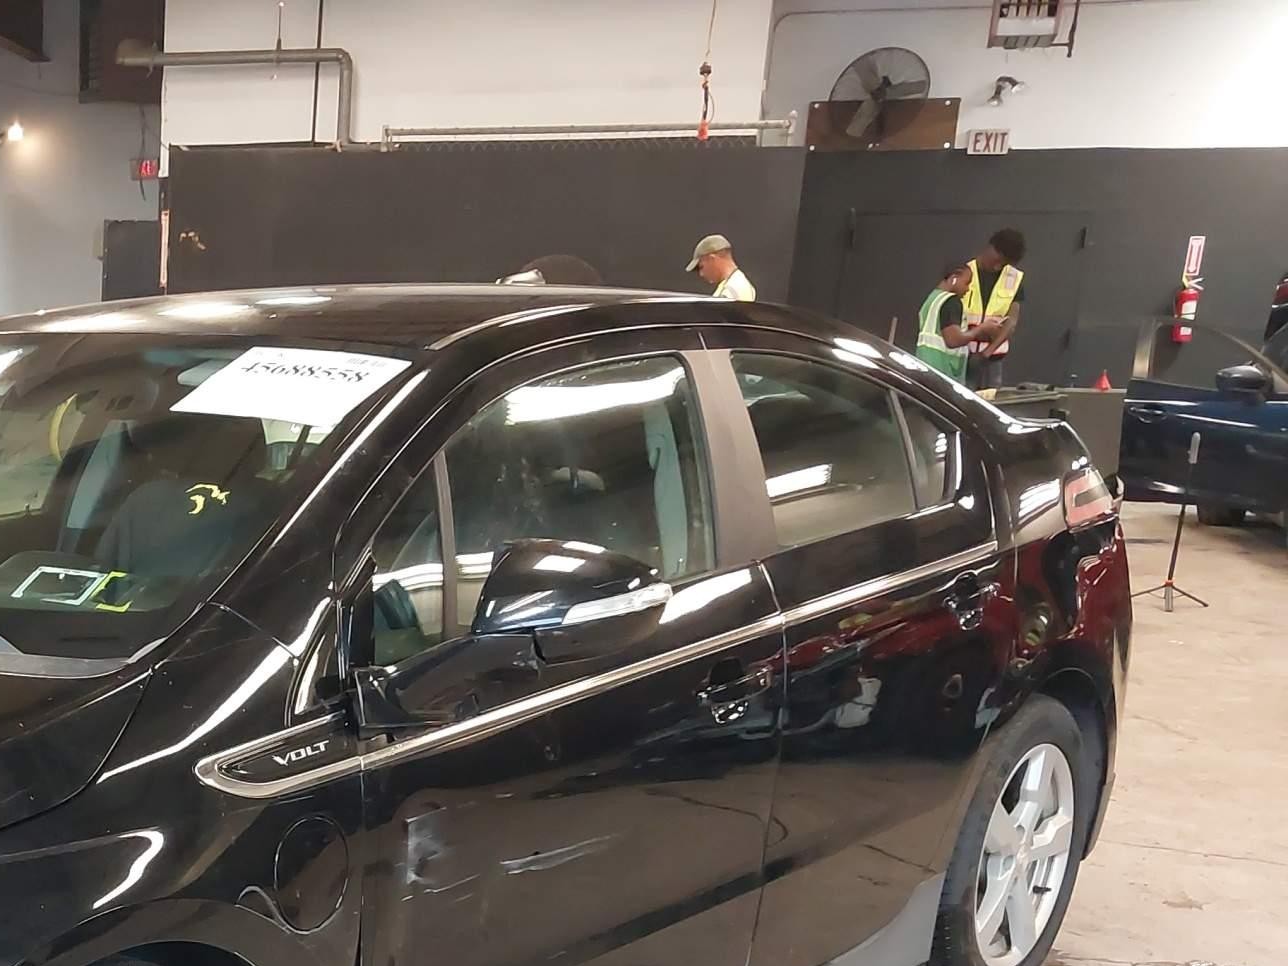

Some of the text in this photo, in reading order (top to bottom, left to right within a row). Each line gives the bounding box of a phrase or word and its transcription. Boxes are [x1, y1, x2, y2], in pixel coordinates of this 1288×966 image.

[973, 132, 1008, 153] EXIT
[240, 361, 370, 383] 45688558
[272, 740, 330, 766] VOLT
